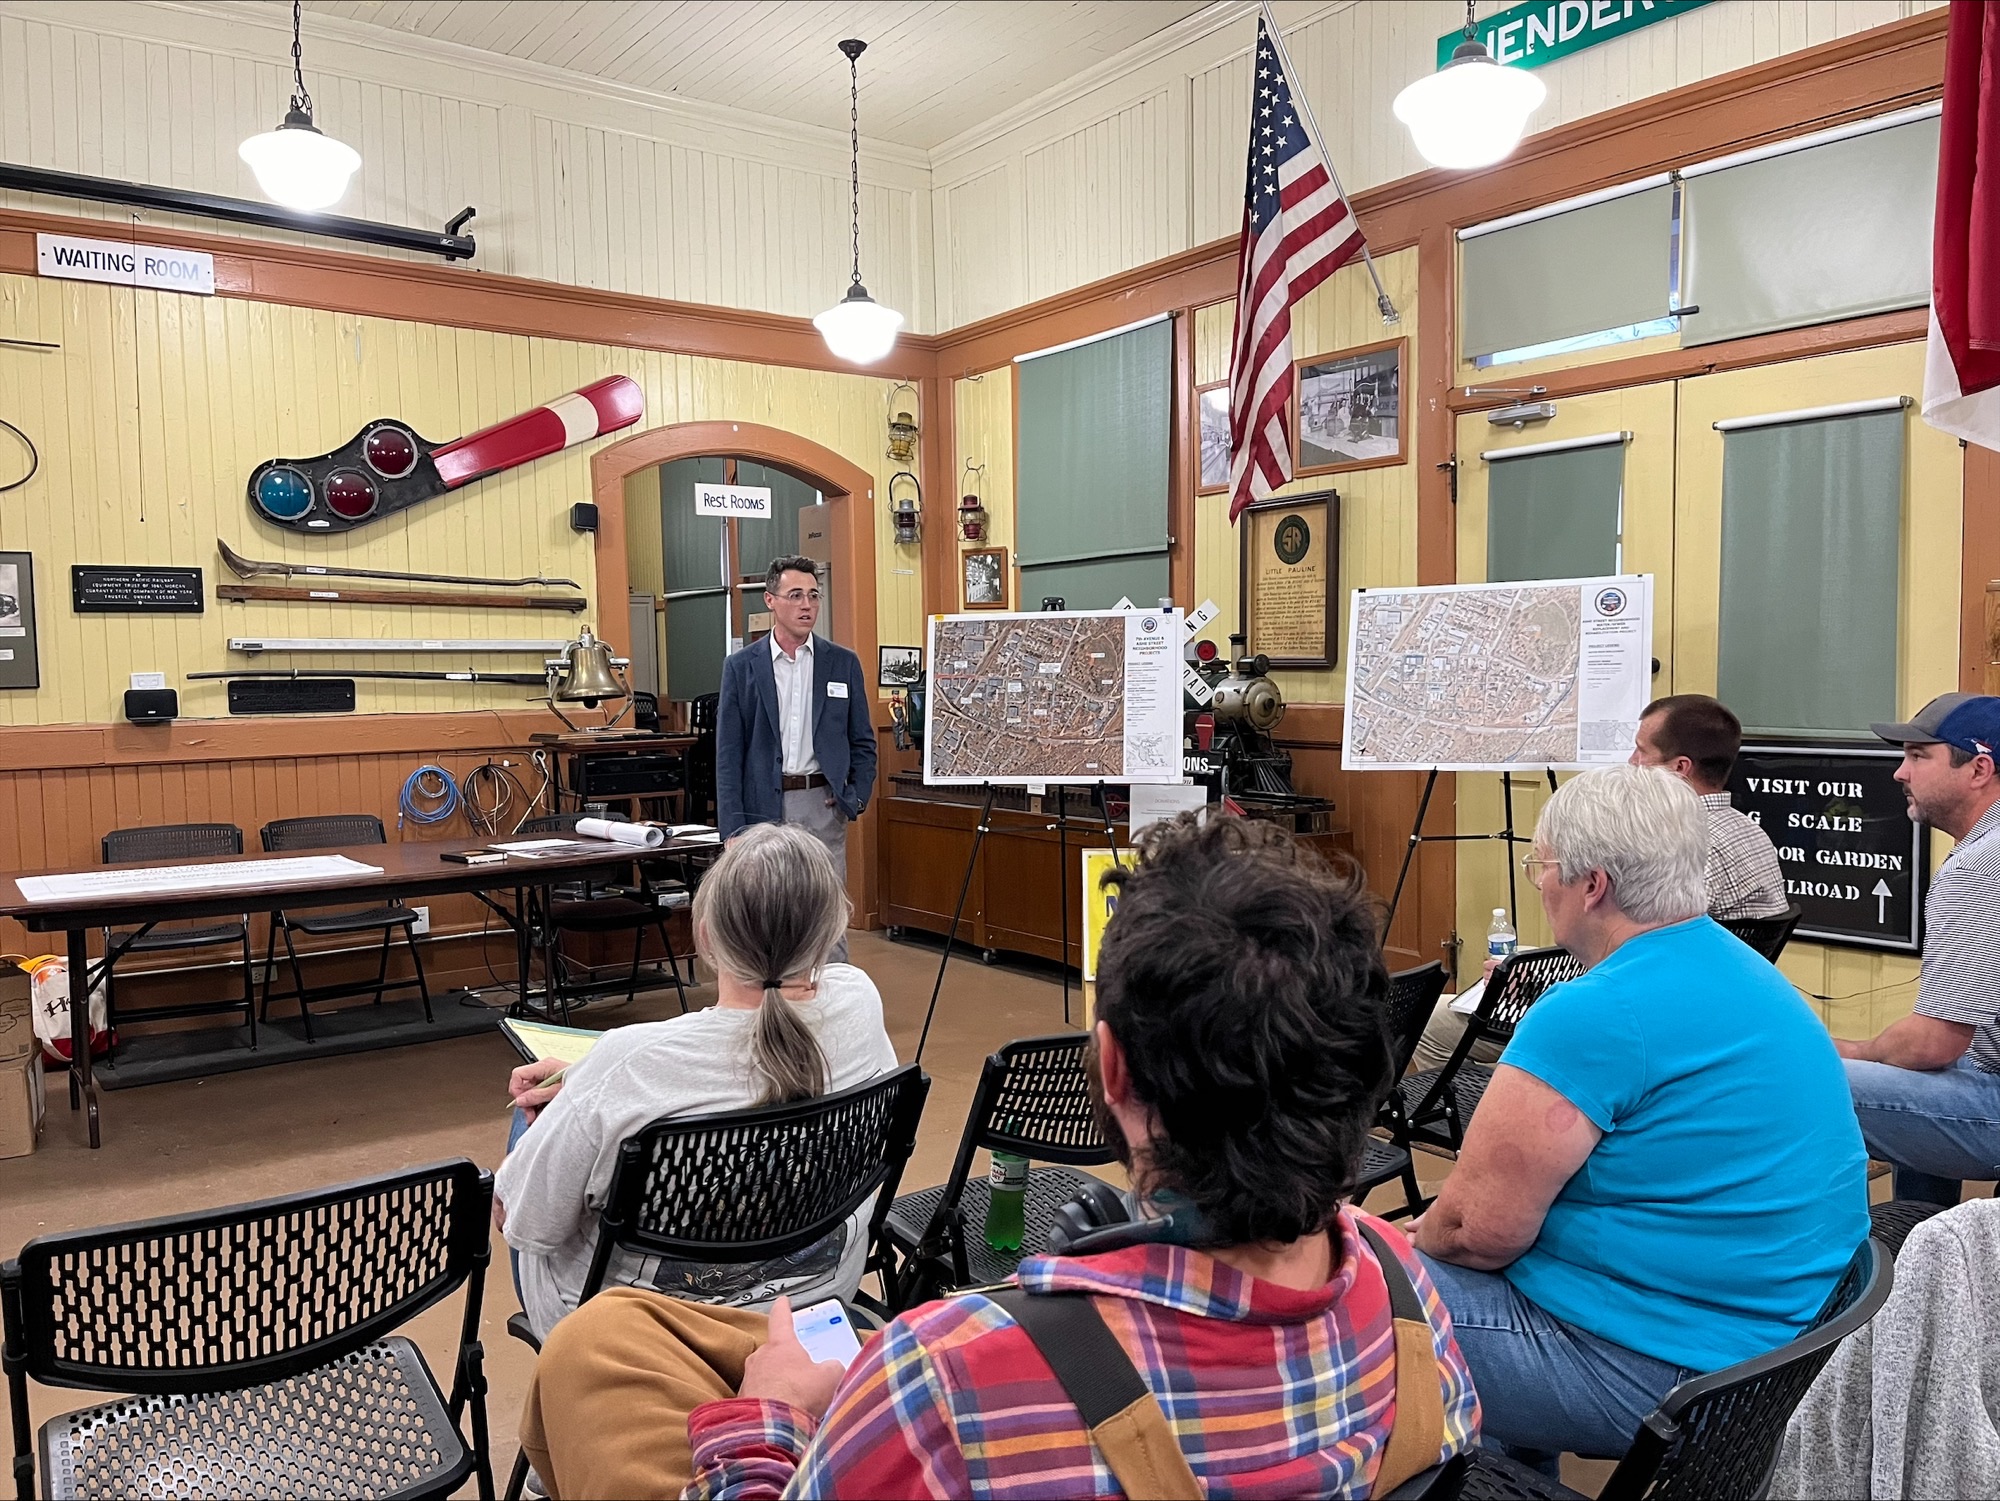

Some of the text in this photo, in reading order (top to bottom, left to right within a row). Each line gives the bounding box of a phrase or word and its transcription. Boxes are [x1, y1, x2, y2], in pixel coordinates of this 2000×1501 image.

[53, 246, 199, 281] WAITING ROOM
[703, 493, 728, 509] Rest
[1288, 565, 1316, 573] PAULINE
[1746, 778, 1863, 798] VISIT OUR
[1788, 813, 1862, 832] SCALE
[1815, 850, 1903, 871] GARDEN
